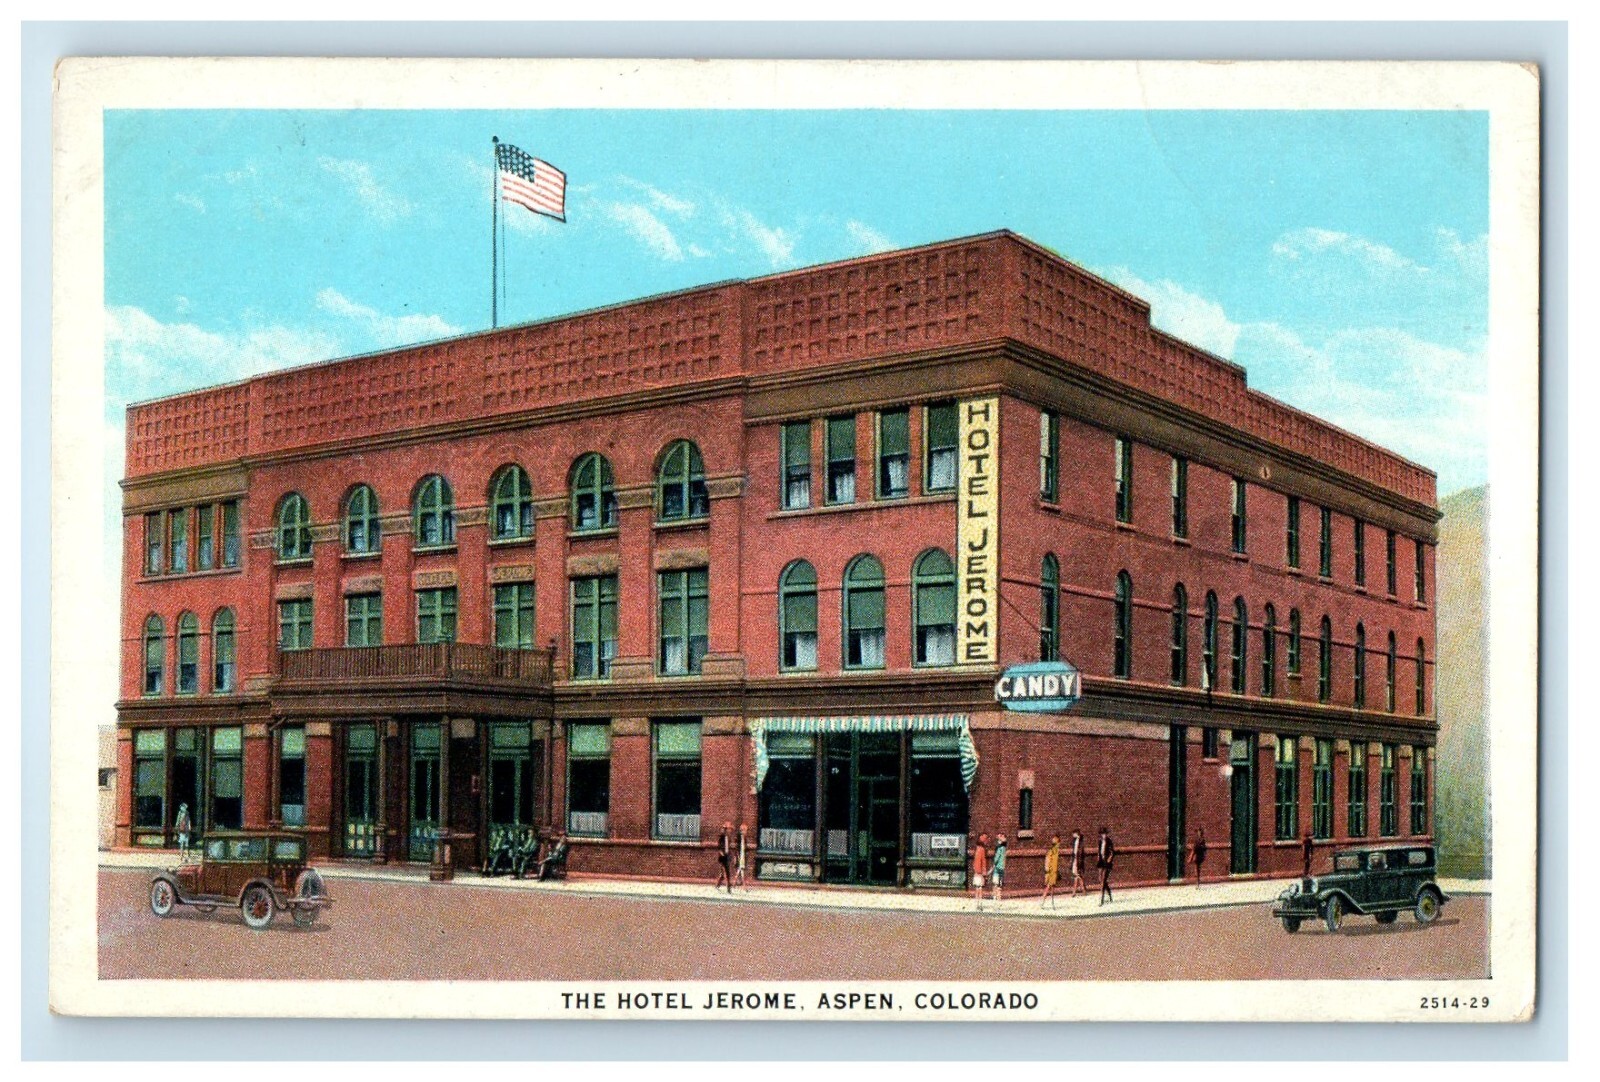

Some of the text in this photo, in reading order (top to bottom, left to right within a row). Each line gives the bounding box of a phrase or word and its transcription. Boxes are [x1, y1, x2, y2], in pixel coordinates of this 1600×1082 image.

[966, 403, 990, 660] HOTEL JEROME
[998, 673, 1076, 698] CANDY
[561, 992, 1038, 1012] THE HOTEL JEROME, ASPEN, COLORADO
[1420, 996, 1490, 1009] 2514-29
